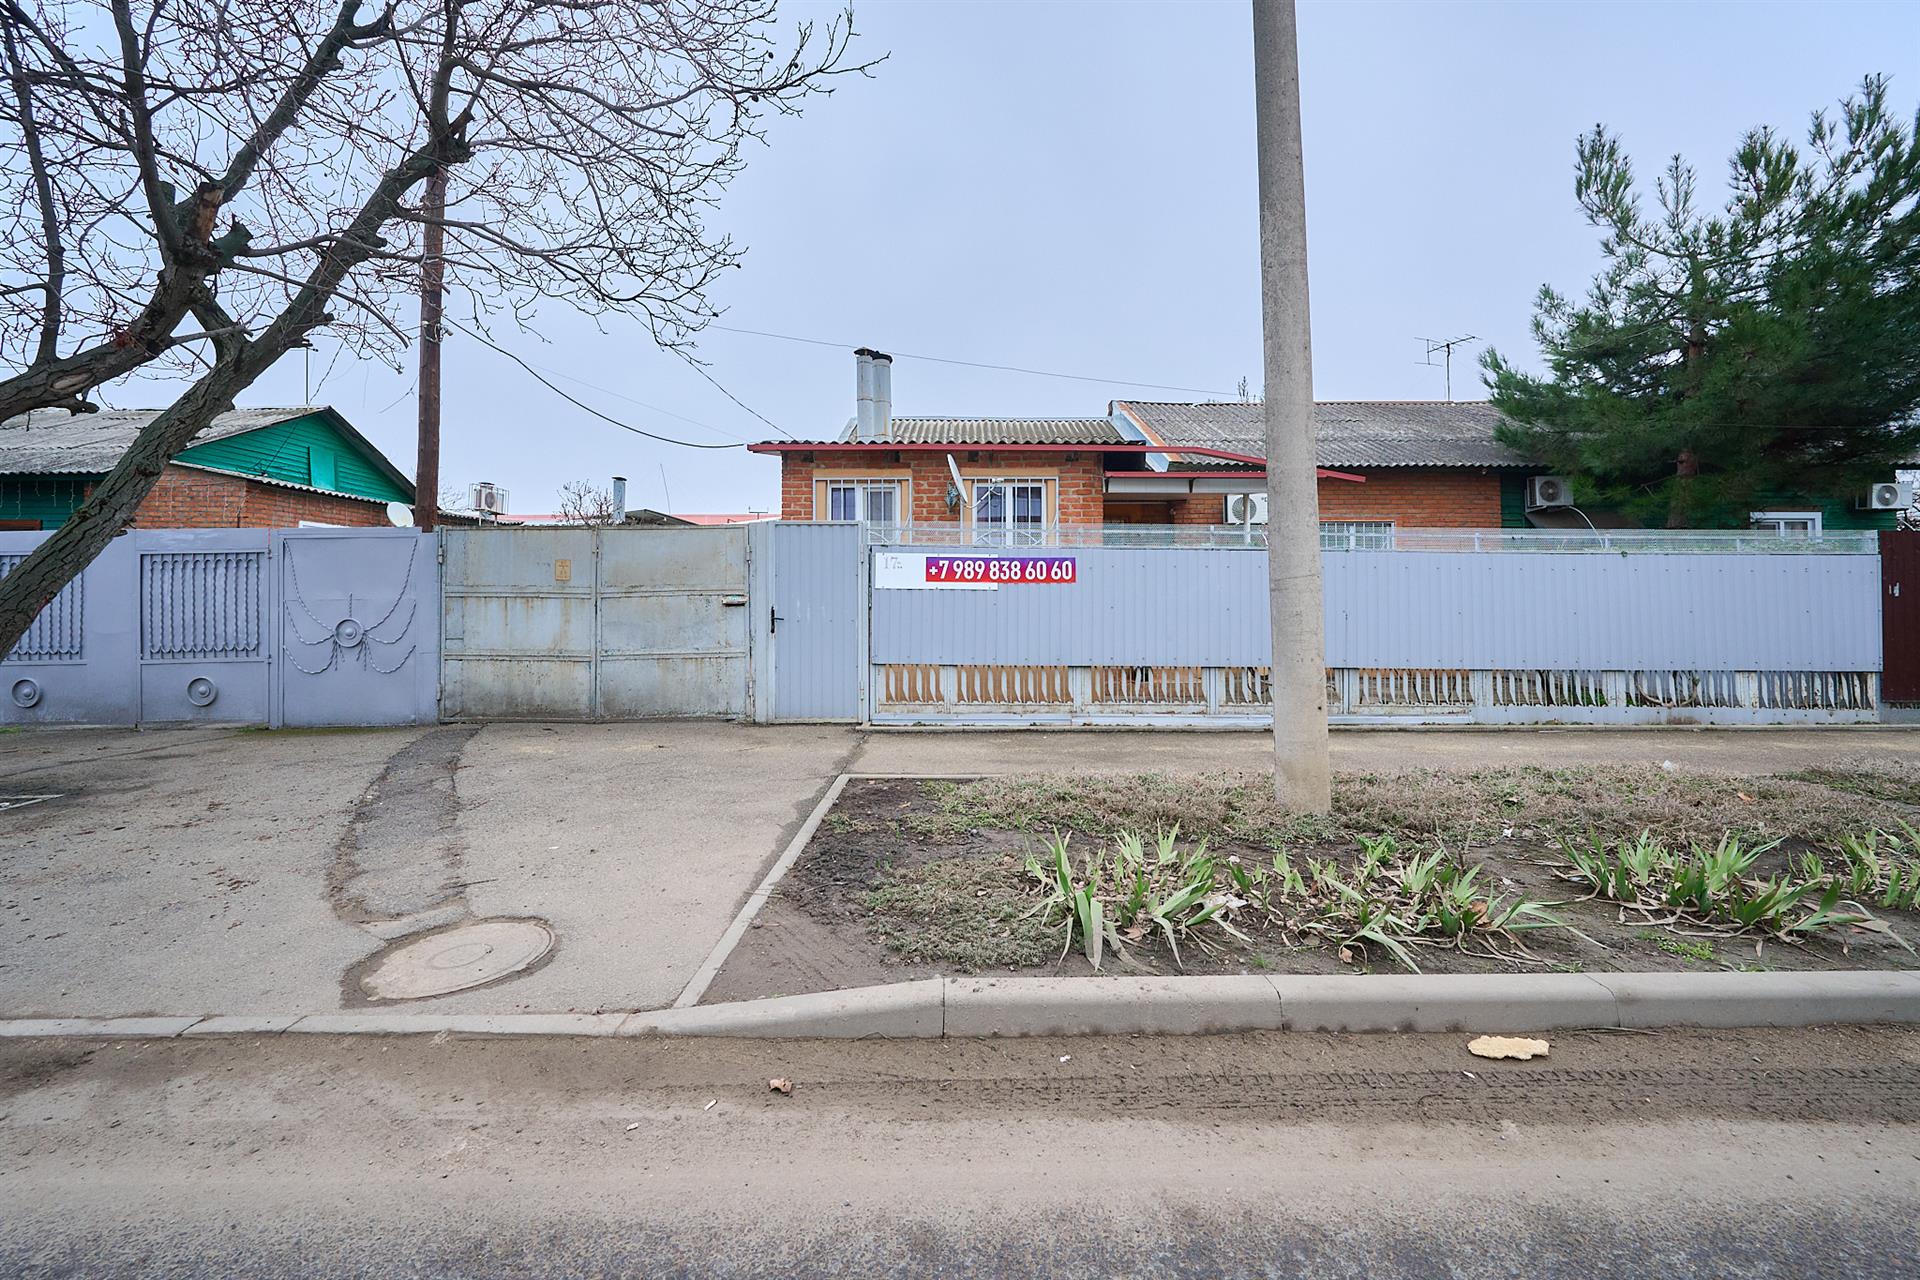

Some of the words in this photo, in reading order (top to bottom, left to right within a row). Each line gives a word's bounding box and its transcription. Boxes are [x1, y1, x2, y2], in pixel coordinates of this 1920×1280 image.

[928, 560, 949, 579] +7
[953, 560, 985, 580] 989
[989, 560, 1021, 580] 838
[1025, 560, 1047, 580] 60
[1051, 560, 1073, 580] 60
